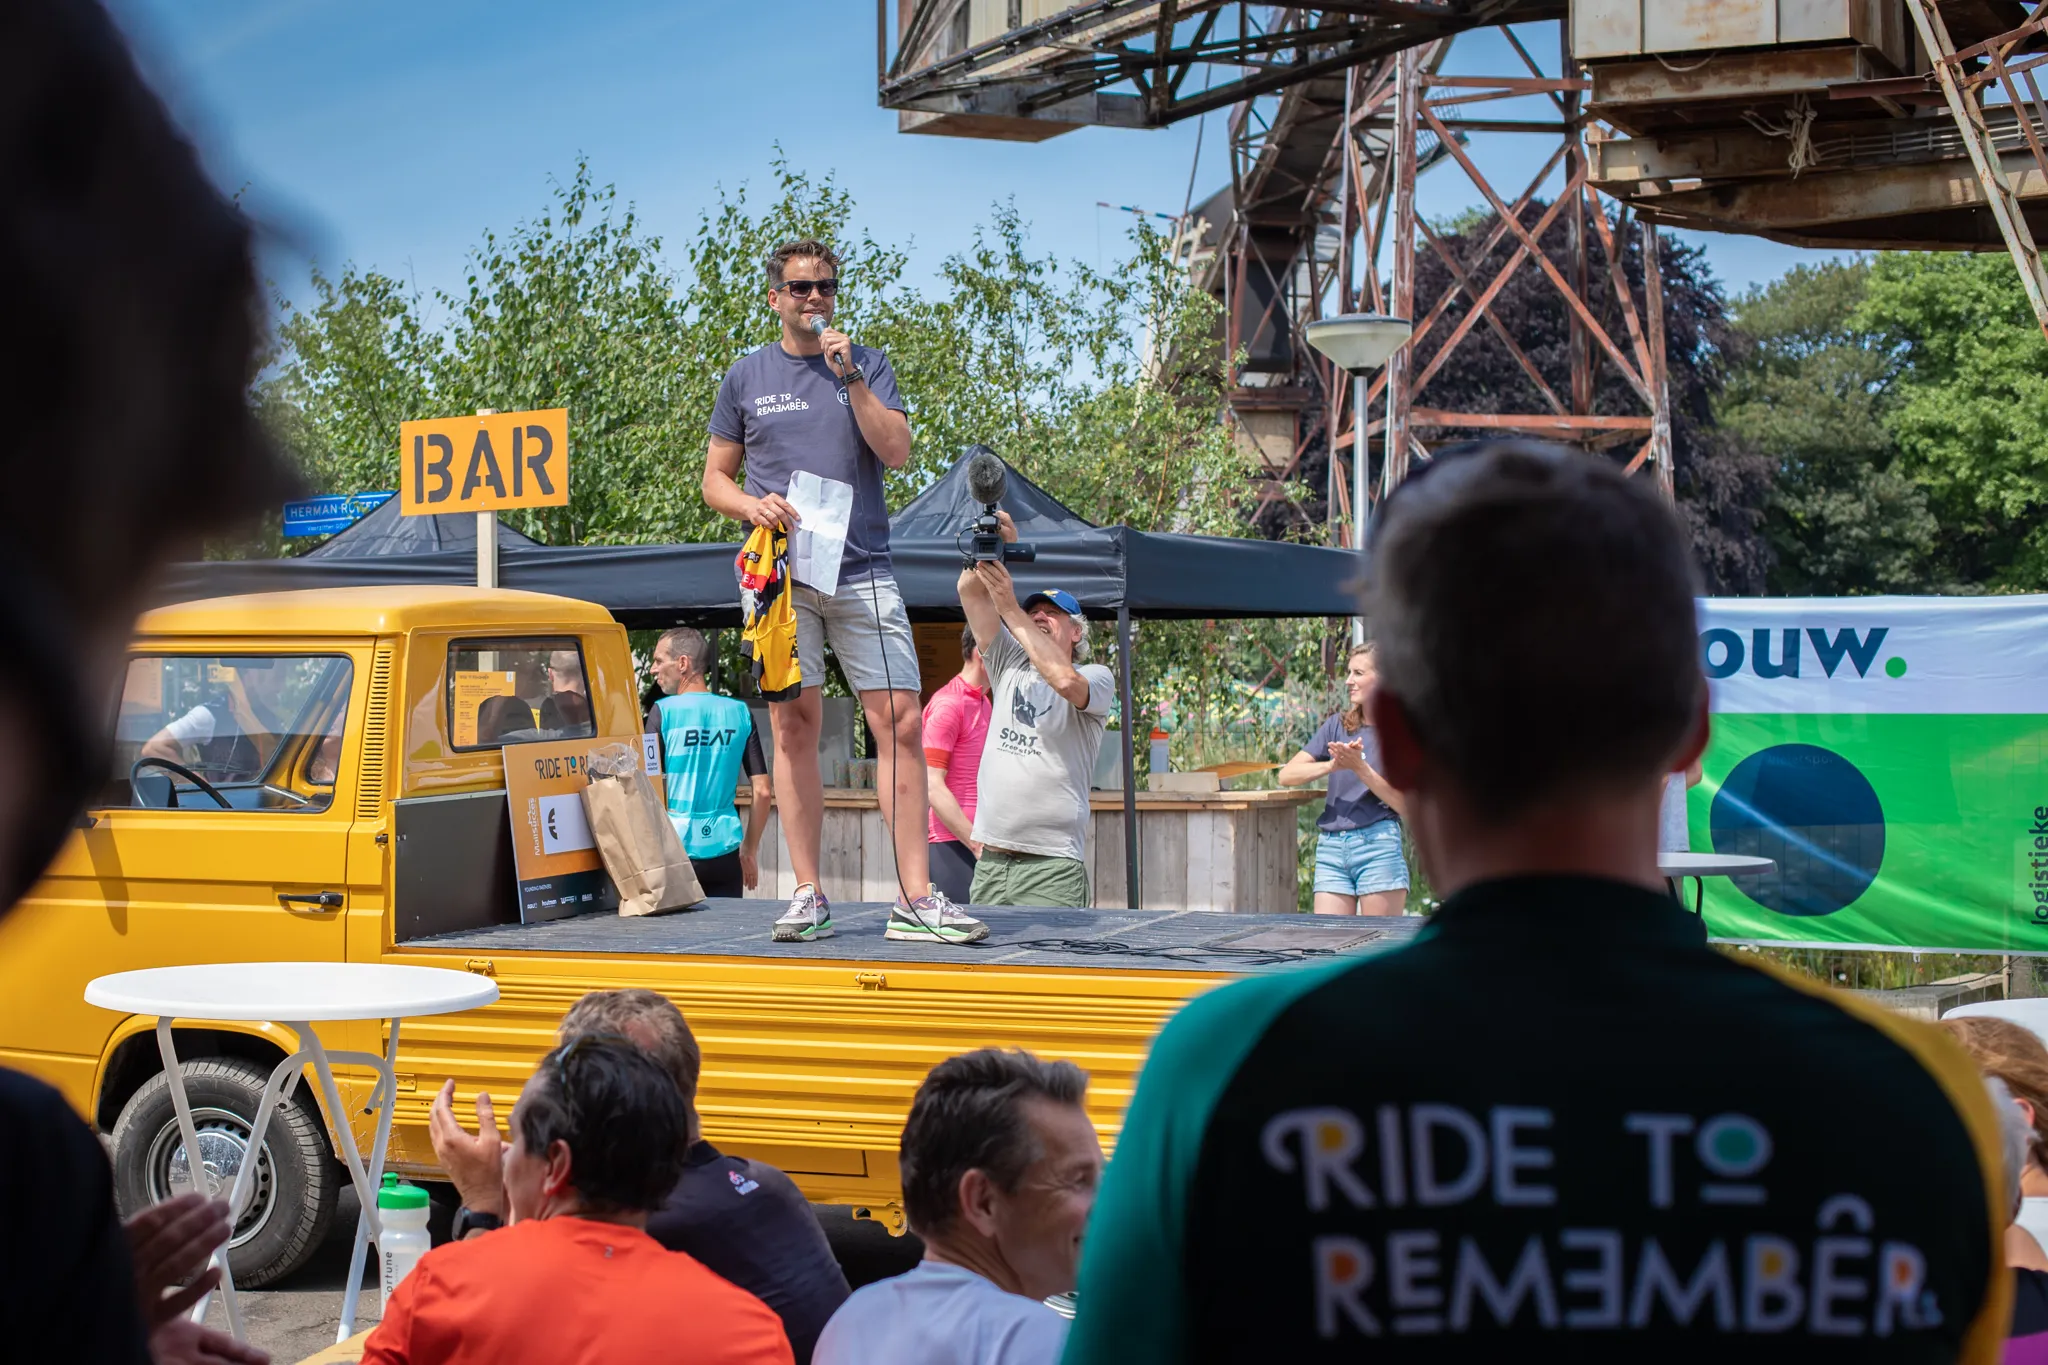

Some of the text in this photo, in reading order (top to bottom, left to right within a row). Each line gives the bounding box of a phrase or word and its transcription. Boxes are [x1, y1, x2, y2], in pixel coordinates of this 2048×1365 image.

[754, 392, 791, 406] RIDE TO
[414, 425, 555, 504] BAR
[290, 504, 337, 517] HERMAN
[683, 728, 736, 747] BEAT
[1000, 728, 1038, 747] SORT
[534, 755, 561, 780] RIDE
[563, 755, 577, 777] TO
[2028, 805, 2048, 926] logistieke
[1261, 1104, 1773, 1209] RIDE TO
[385, 1251, 393, 1295] ortune
